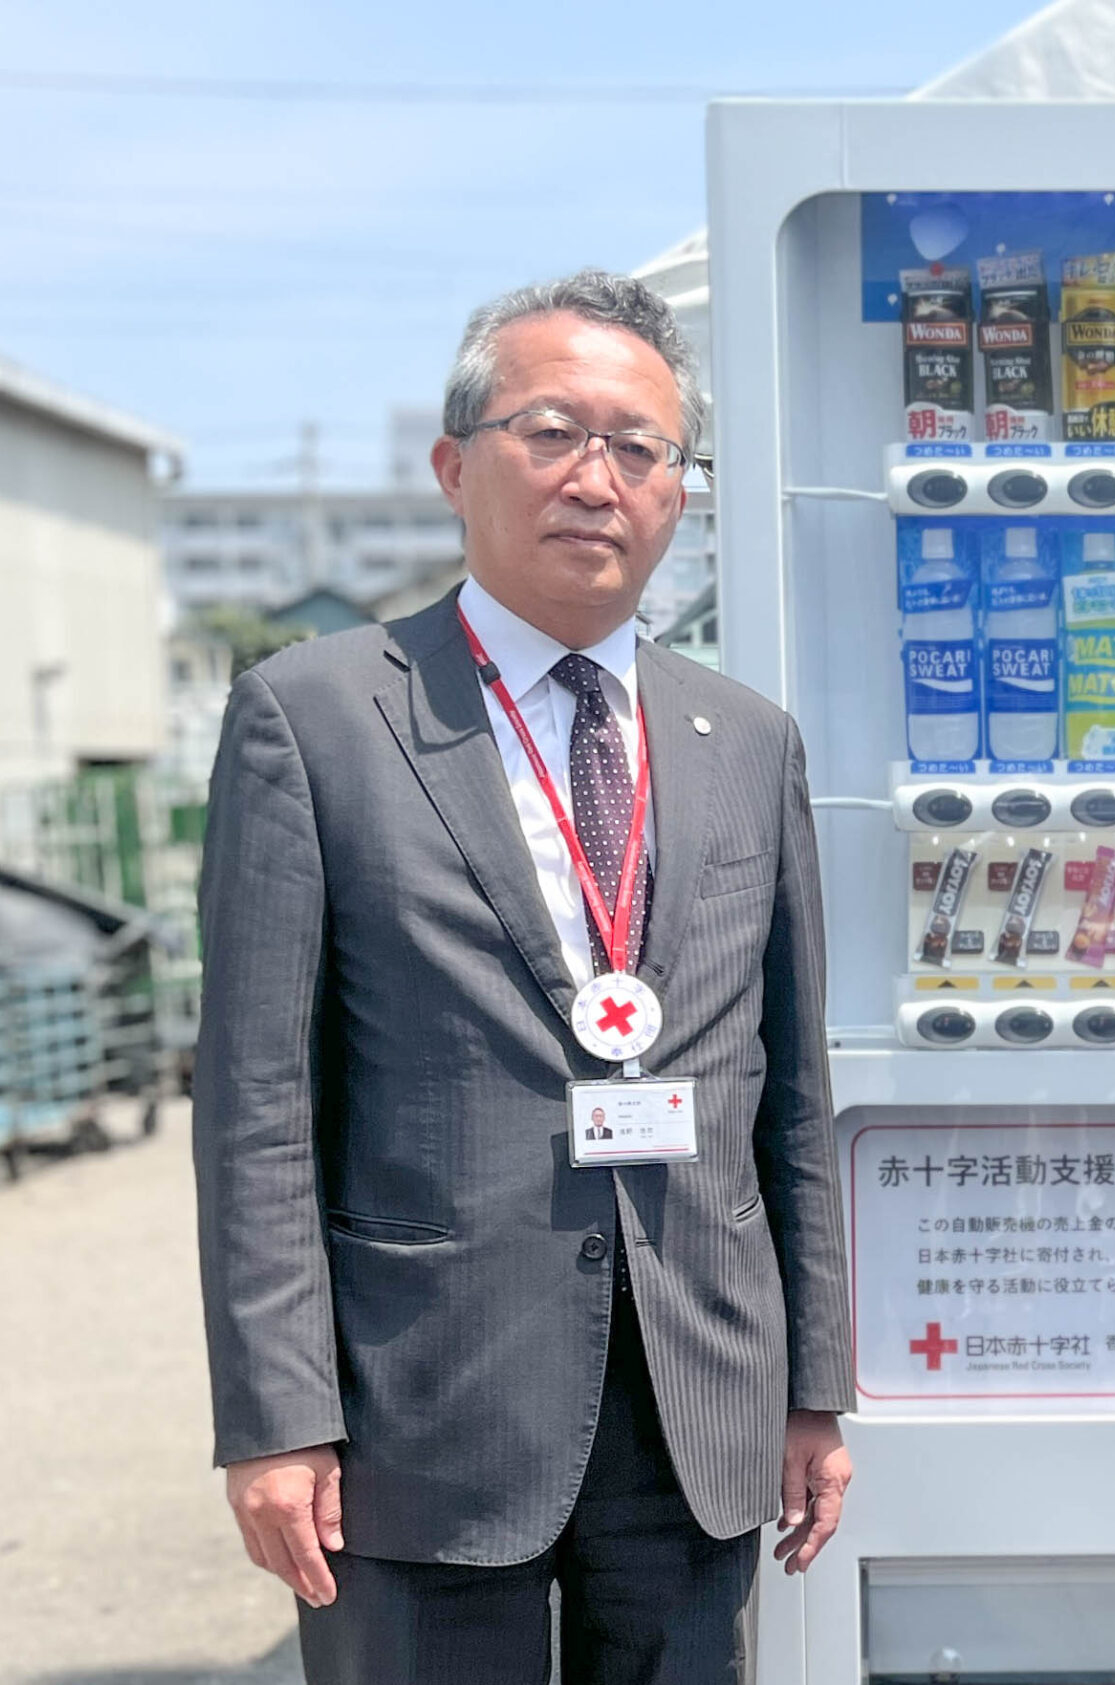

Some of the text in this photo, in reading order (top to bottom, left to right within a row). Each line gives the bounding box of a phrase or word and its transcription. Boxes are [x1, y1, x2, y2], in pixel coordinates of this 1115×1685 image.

[911, 323, 961, 340] WONDA
[982, 325, 1028, 344] WONDA
[919, 364, 957, 378] BLACK
[993, 366, 1027, 380] BLACK
[908, 410, 936, 439] 朝
[985, 411, 1009, 440] 朝
[938, 425, 967, 439] ブラック
[1010, 426, 1039, 440] ブラック
[909, 649, 972, 664] POCARI
[992, 649, 1055, 663] POCARI
[909, 663, 968, 677] SWEAT
[992, 663, 1051, 676] SWEAT
[939, 857, 969, 915] SOYJOY
[1014, 858, 1043, 915] SOYJOY
[965, 1335, 1091, 1357] 日本赤十字社
[1011, 1361, 1030, 1371] Red
[1058, 1360, 1091, 1372] Society
